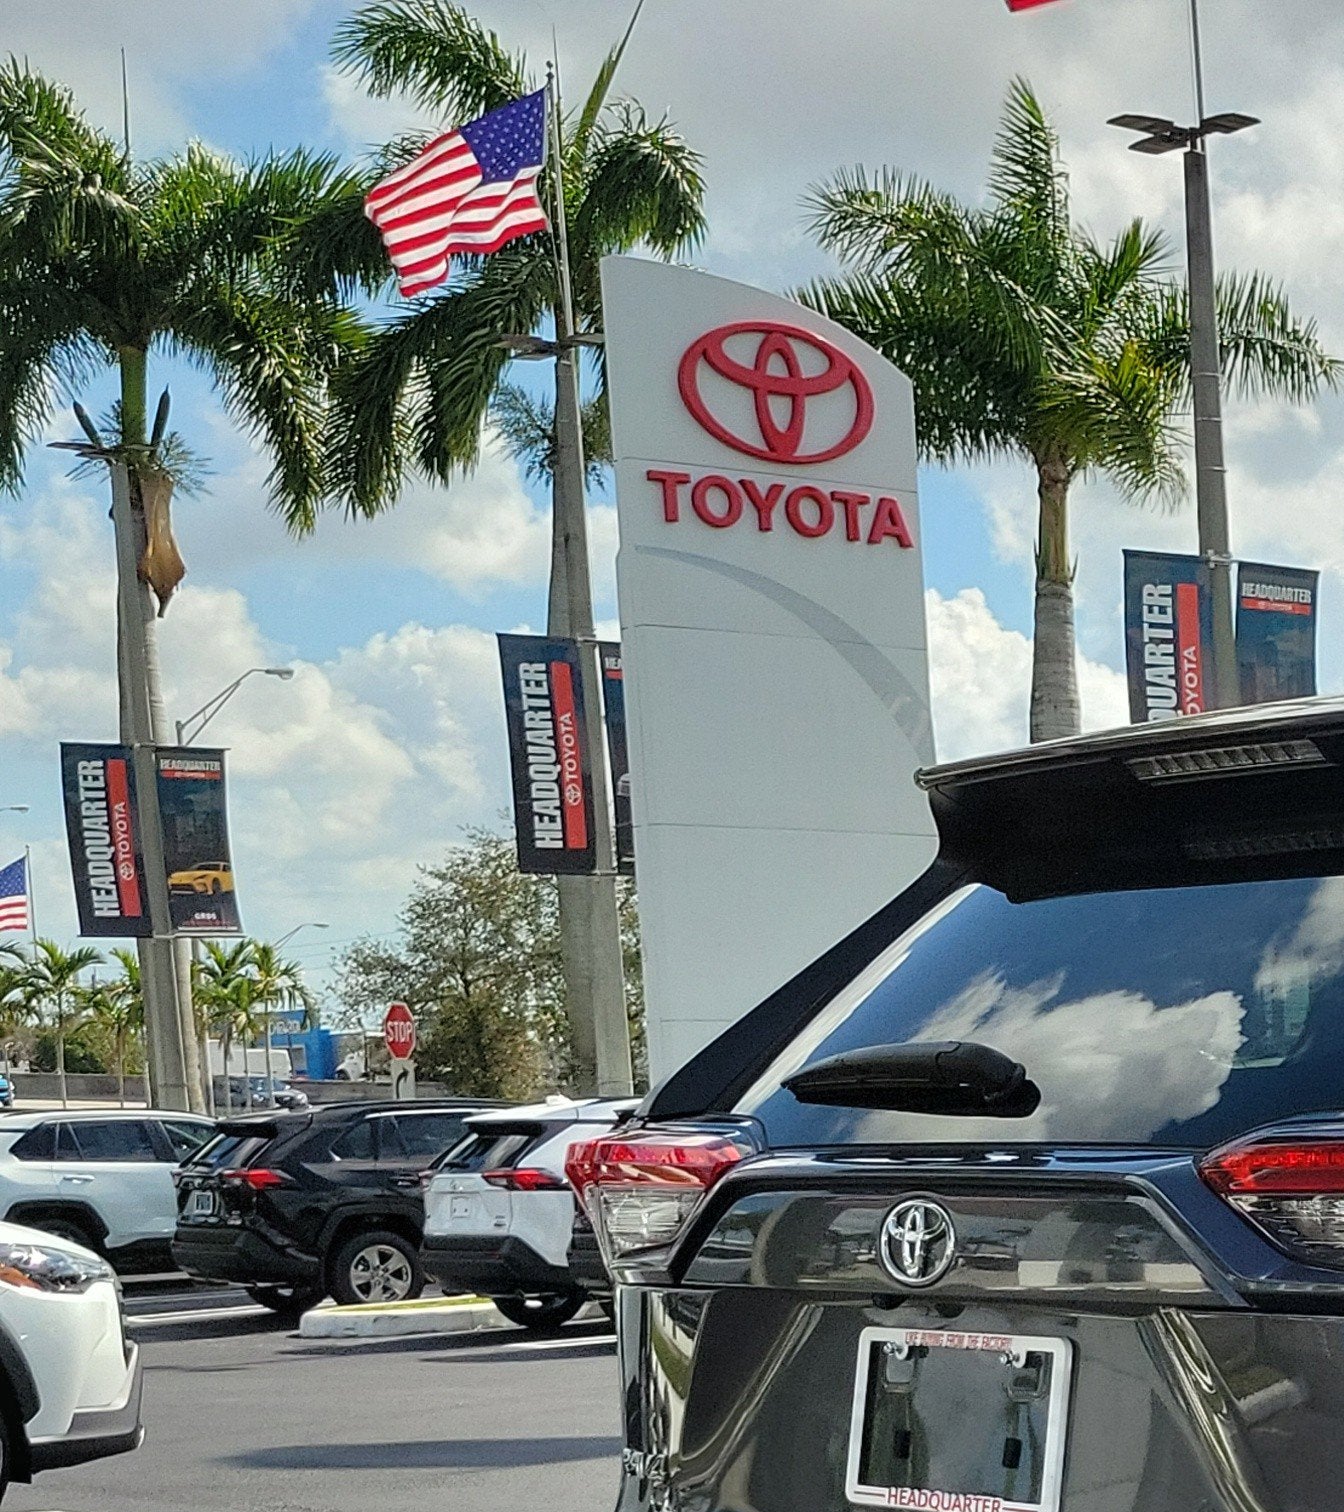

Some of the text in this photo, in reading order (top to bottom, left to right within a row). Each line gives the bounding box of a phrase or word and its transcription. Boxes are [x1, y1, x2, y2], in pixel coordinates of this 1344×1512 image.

[646, 470, 914, 548] TOYOTA
[518, 662, 564, 849] HEADQUARTER
[558, 713, 579, 780] TOYOTA
[77, 760, 121, 917] HEADQUARTER
[114, 802, 130, 860] TOYOTA
[387, 1020, 413, 1043] STOP
